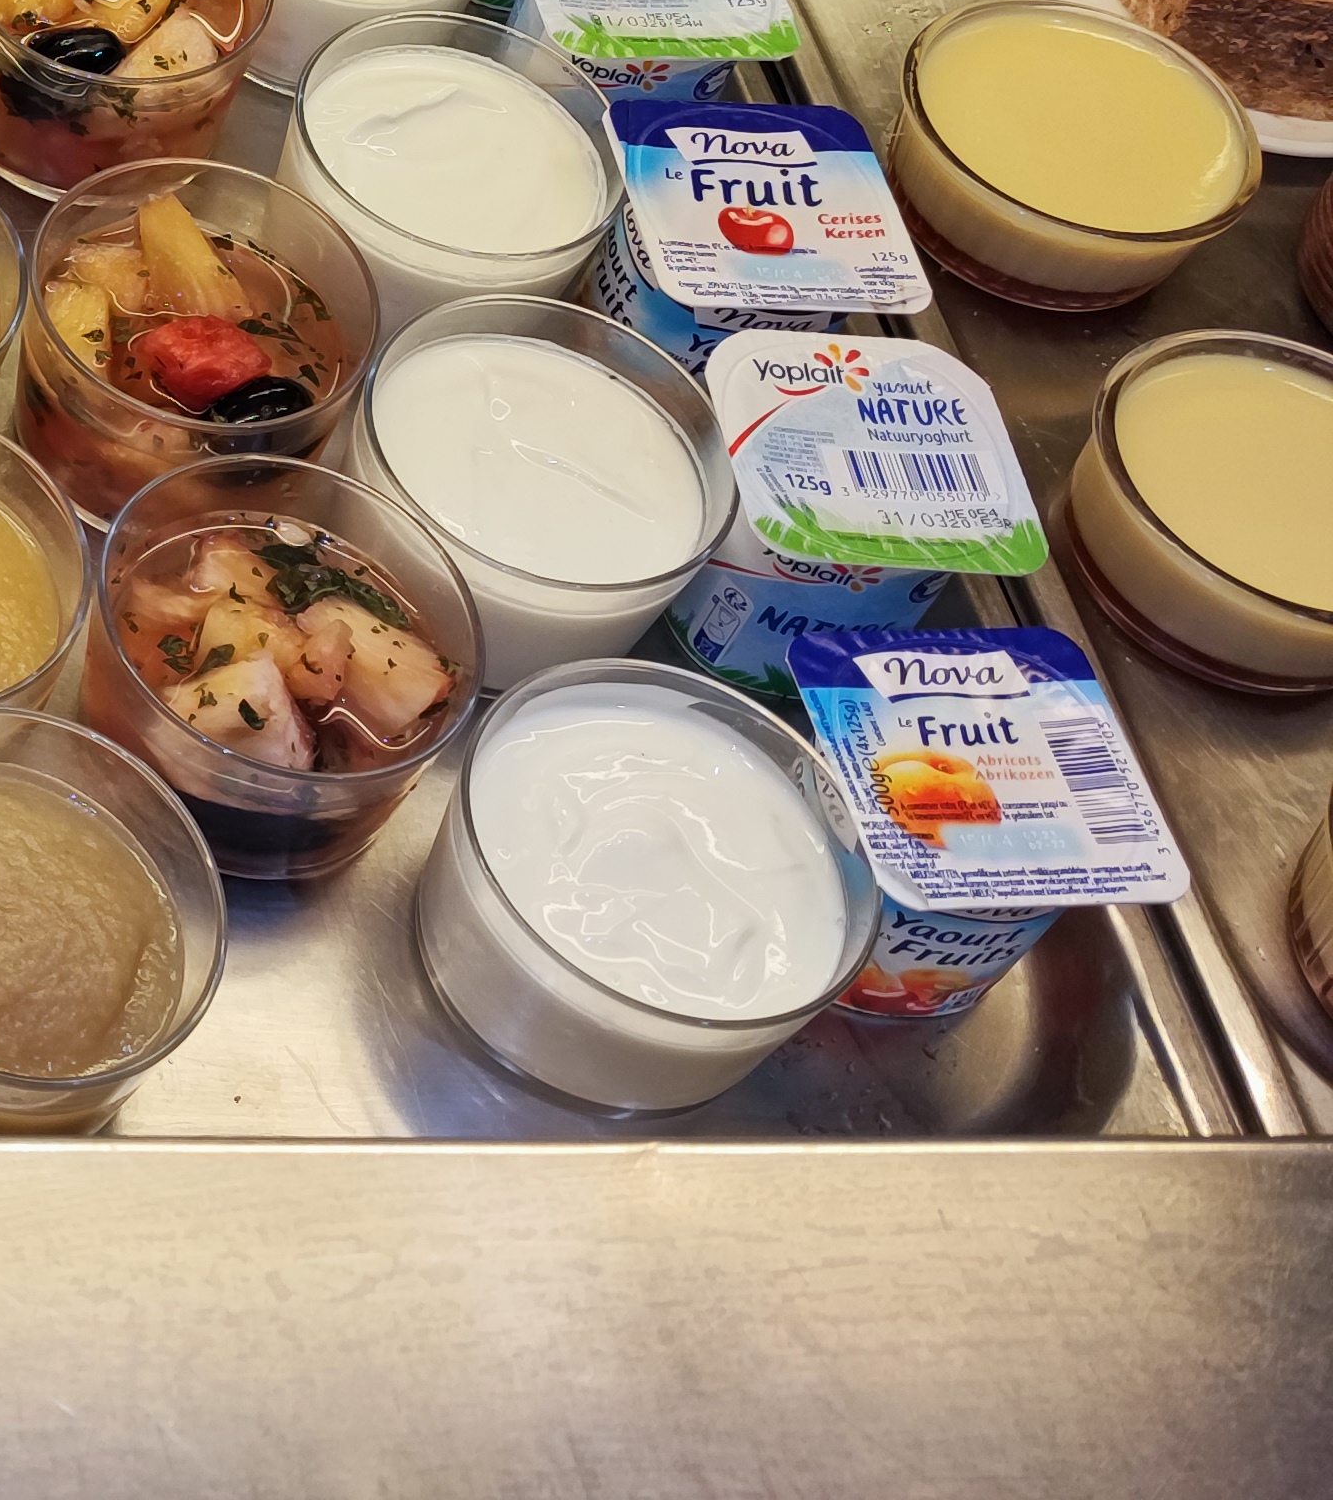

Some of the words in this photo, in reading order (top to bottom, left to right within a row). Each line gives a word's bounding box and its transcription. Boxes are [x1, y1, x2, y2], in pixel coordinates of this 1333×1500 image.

[690, 131, 796, 157] Nova
[665, 167, 684, 181] Le
[690, 168, 823, 207] Fruit
[817, 212, 882, 226] Cerises
[825, 227, 886, 239] Kersen
[872, 252, 909, 265] 125g
[856, 398, 969, 426] NATURE
[867, 427, 974, 446] Natuuryoghurt
[784, 472, 832, 496] 125g
[883, 657, 1004, 687] Nova
[917, 712, 1021, 748] Fruit
[975, 753, 1042, 768] Abricots
[974, 767, 1056, 781] Abrikozen
[891, 911, 1027, 946] Yaourt
[888, 940, 1021, 966] Fruits
